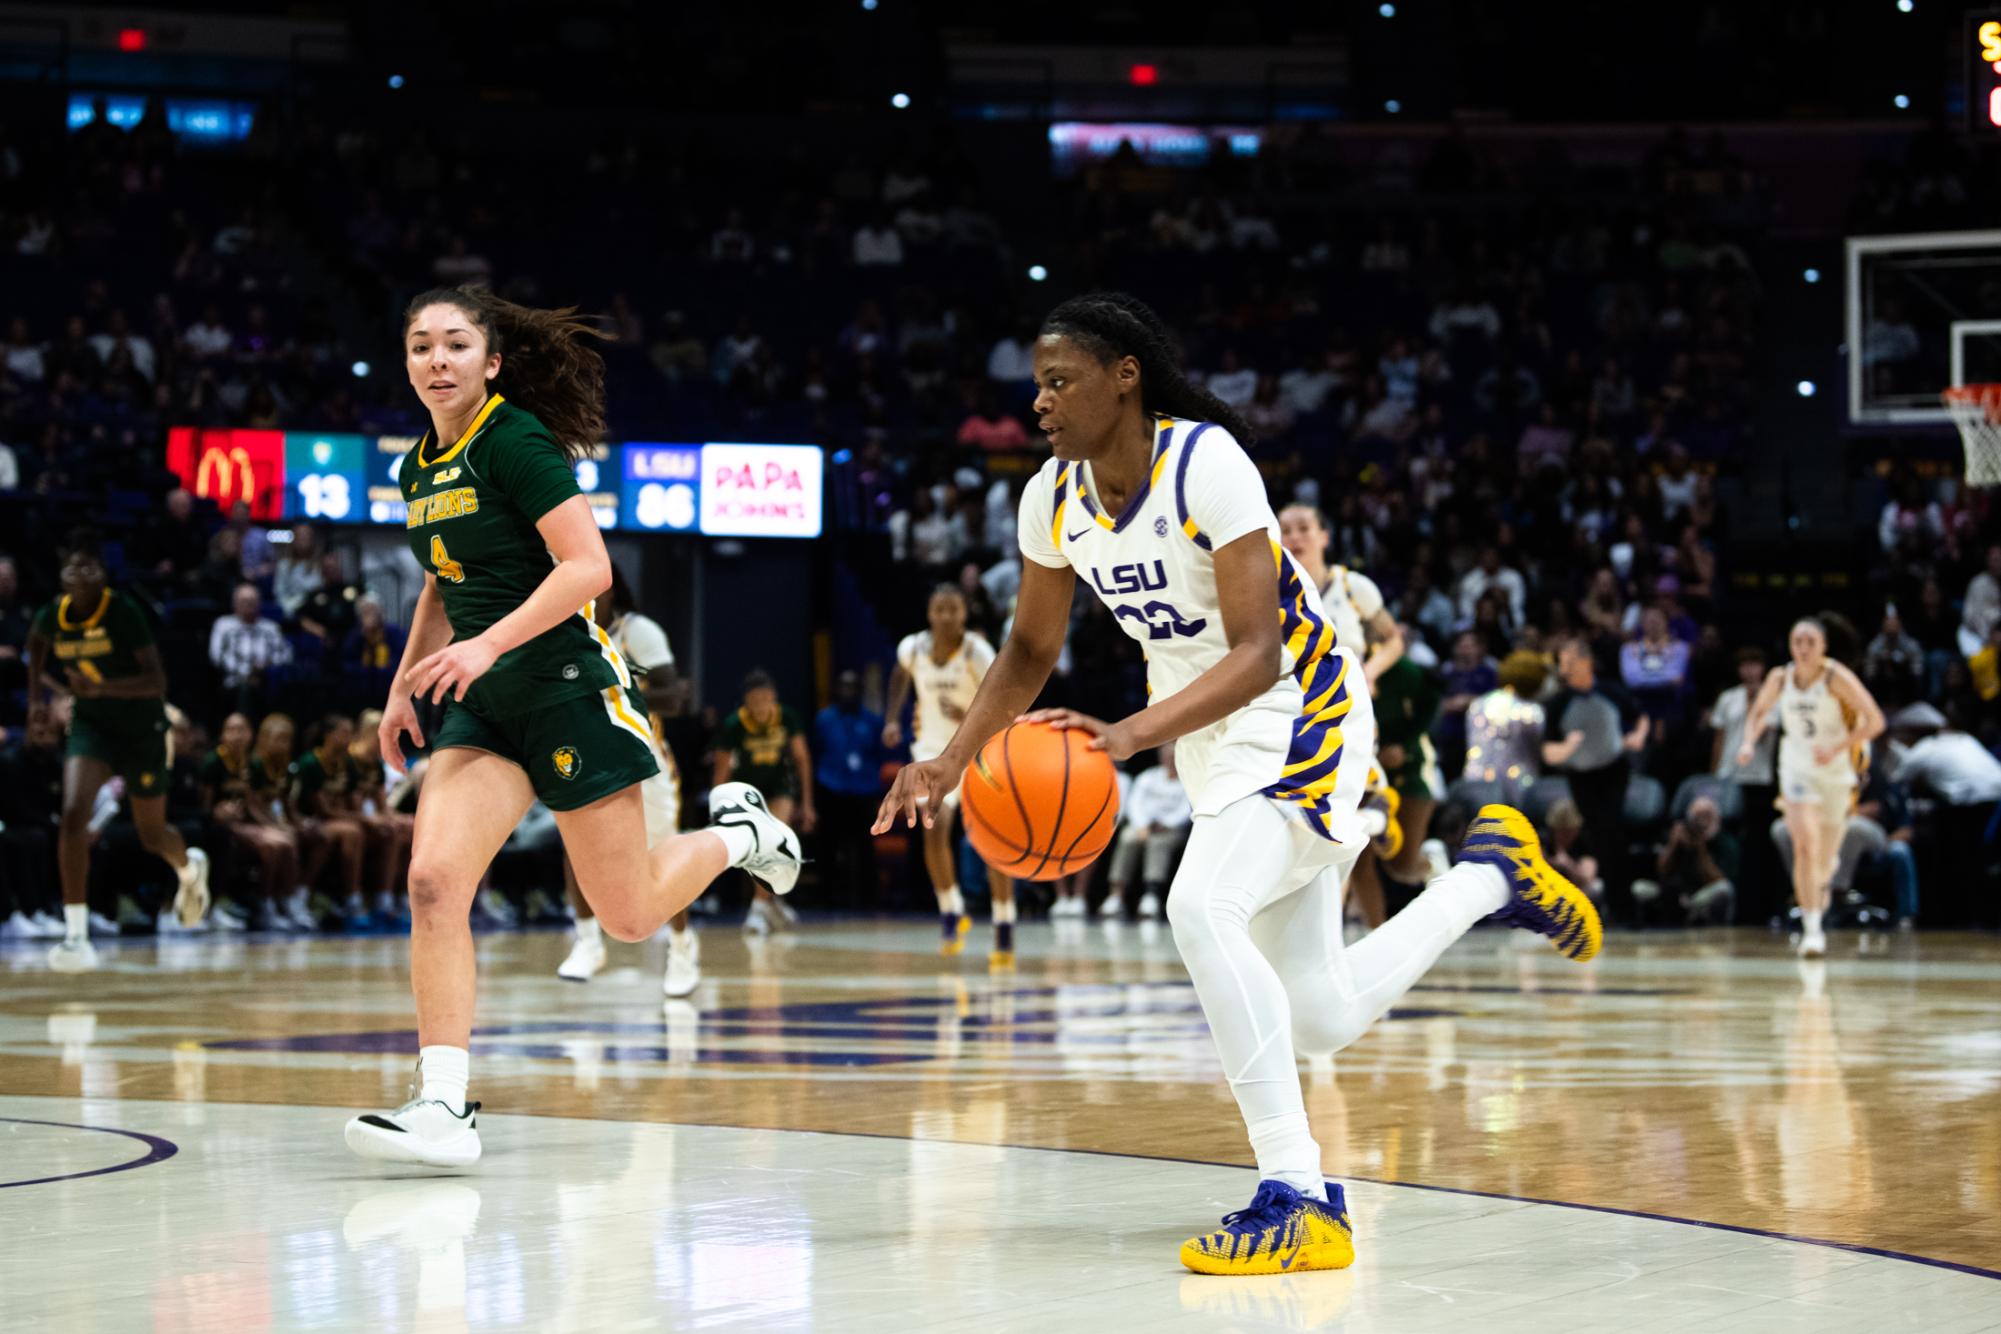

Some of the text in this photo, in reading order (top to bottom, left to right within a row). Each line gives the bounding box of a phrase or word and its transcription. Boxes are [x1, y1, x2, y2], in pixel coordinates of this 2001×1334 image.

[714, 461, 804, 491] PAPA
[299, 473, 351, 519] 13
[426, 486, 479, 524] LIONS
[430, 534, 465, 583] 4
[1091, 559, 1168, 595] LSU
[1114, 600, 1207, 640] 22
